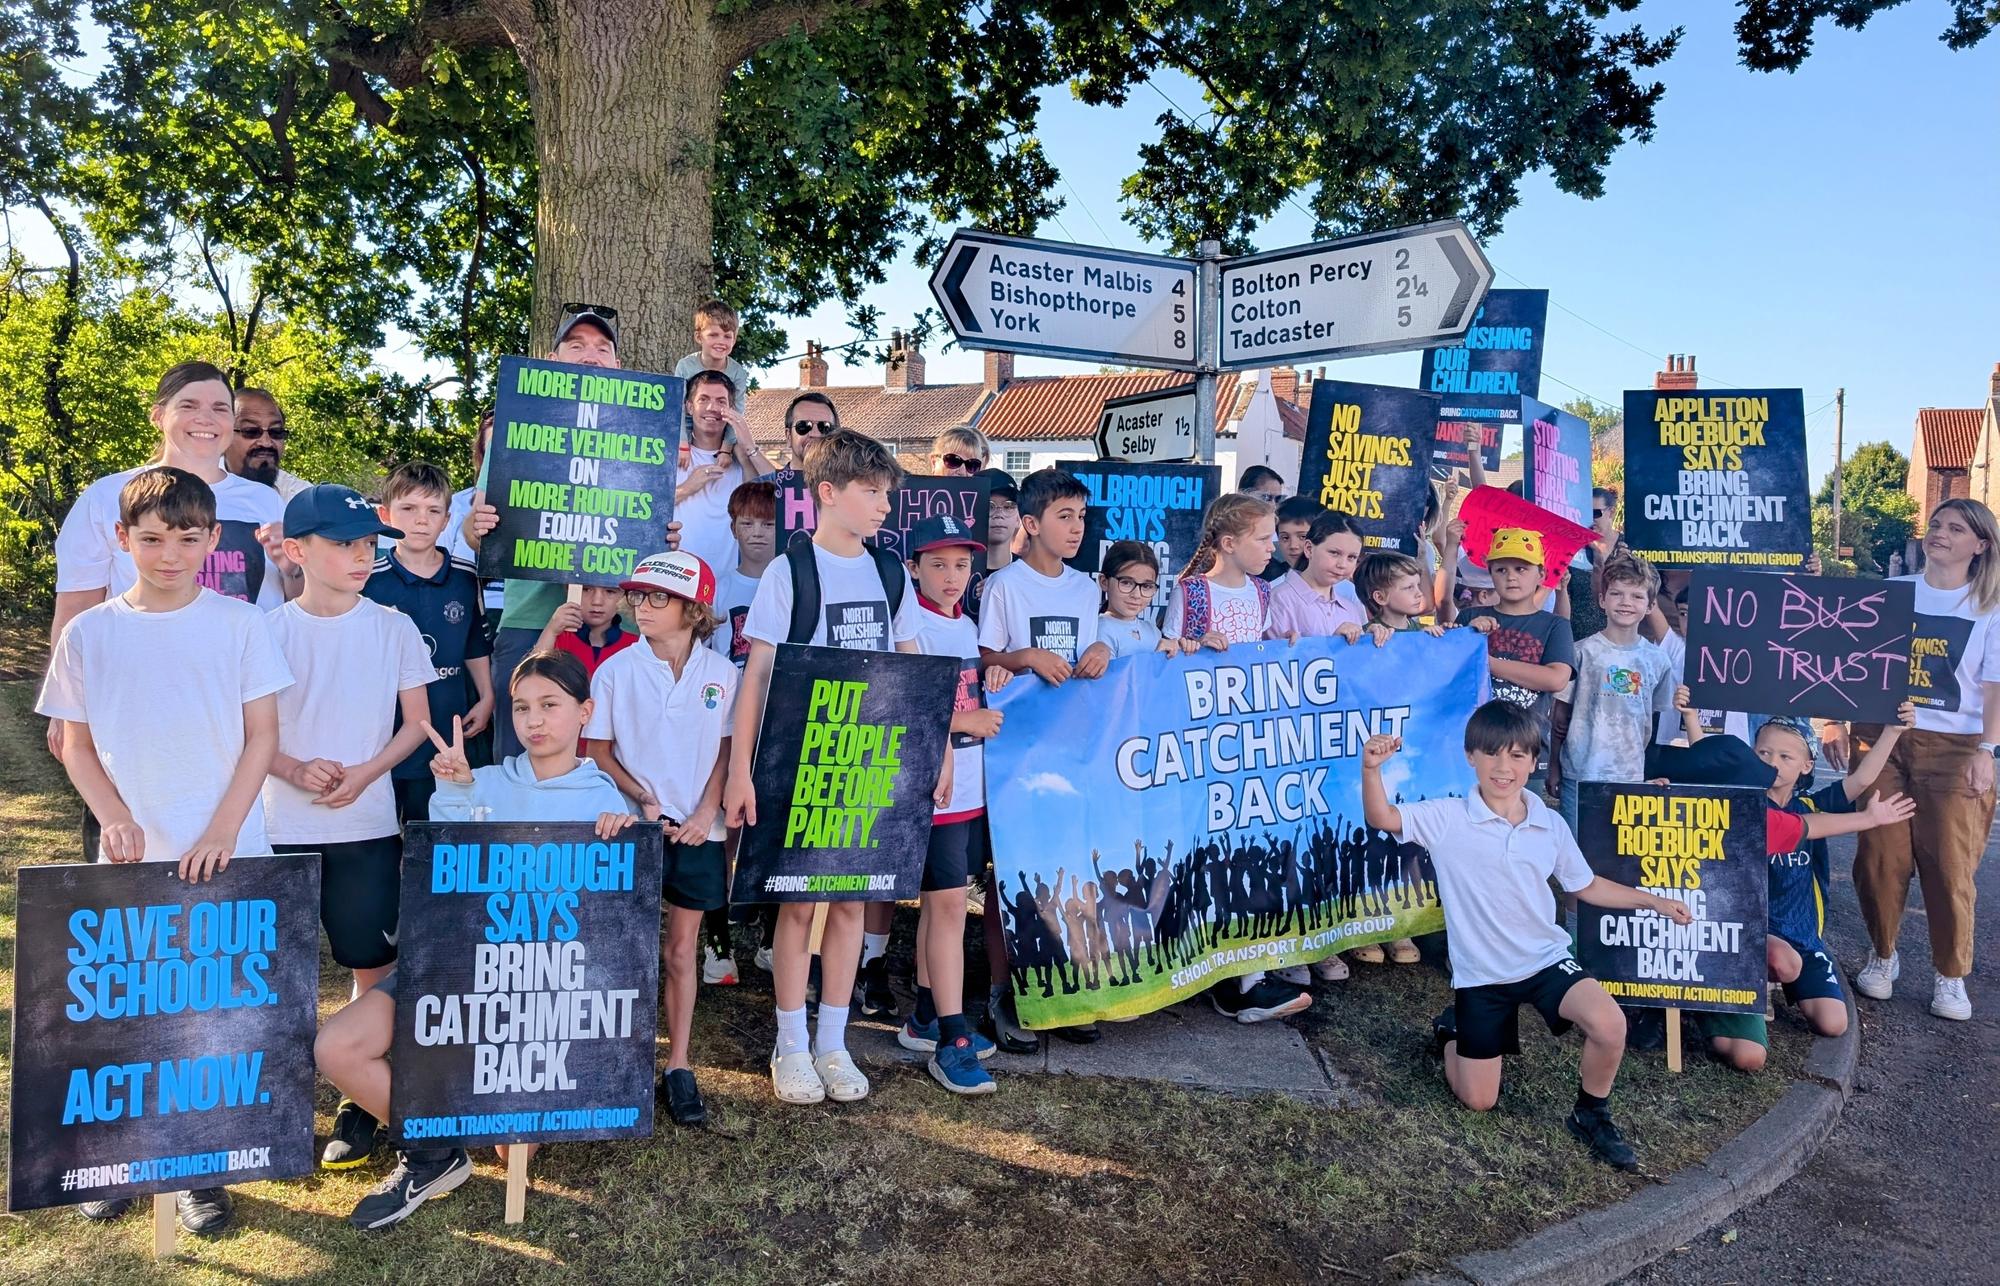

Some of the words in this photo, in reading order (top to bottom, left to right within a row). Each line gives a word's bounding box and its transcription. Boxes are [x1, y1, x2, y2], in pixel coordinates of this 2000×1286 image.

[989, 254, 1074, 284] Acaster
[1084, 266, 1153, 294] Malbis
[1171, 279, 1186, 298] 4
[1232, 272, 1300, 298] Bolton
[1310, 259, 1372, 285] Percy
[1395, 248, 1410, 271] 2
[990, 281, 1136, 319] Bishopthorpe
[1173, 304, 1186, 324] 5
[1231, 298, 1301, 324] Colton
[990, 307, 1041, 333] York
[1173, 329, 1187, 349] 8
[1230, 320, 1335, 349] Tadcaster
[1397, 305, 1412, 328] 5
[1434, 348, 1470, 371] OUR
[517, 367, 579, 400] MORE
[579, 375, 666, 411] DRIVERS
[1431, 371, 1520, 395] CHILDREN.
[576, 402, 599, 429] IN
[1116, 411, 1163, 433] Acaster
[1331, 403, 1362, 434] NO
[1654, 396, 1769, 422] APPLETON
[506, 421, 568, 455] MORE
[571, 428, 666, 465] VEHICLES
[1122, 435, 1156, 455] Selby
[1327, 431, 1413, 467] SAVINGS.
[1534, 418, 1560, 451] STOP
[1660, 421, 1766, 446] ROEBUCK
[568, 456, 600, 487] ON
[1323, 459, 1375, 491] JUST
[1534, 443, 1580, 484] HURTING
[1683, 445, 1743, 471] SAYS
[508, 480, 570, 514] MORE
[572, 486, 653, 520] ROUTES
[1535, 469, 1568, 504] RURAL
[1678, 470, 1749, 496] BRING
[1320, 486, 1384, 519] COSTS.
[1644, 494, 1787, 522] CATCHMENT
[538, 511, 618, 546] EQUALS
[1105, 507, 1166, 541] SAYS
[1681, 521, 1749, 548] BACK.
[513, 538, 577, 572] MORE
[582, 547, 637, 577] COST
[649, 567, 692, 582] FERRARI
[1730, 552, 1766, 566] ACTION
[1767, 553, 1804, 567] GROUP
[842, 606, 874, 624] NORTH
[1704, 586, 1758, 628] NO
[1780, 586, 1887, 634] BUS
[832, 622, 884, 641] YORKSHIRE
[1035, 635, 1077, 649] YORKSHIRE
[1045, 621, 1072, 635] NORTH
[1698, 646, 1752, 685] NO
[1768, 645, 1907, 692] TRUST
[807, 679, 869, 723] PUT
[1183, 657, 1338, 721] BRING
[799, 722, 907, 766] PEOPLE
[1115, 704, 1411, 792] CATCHMENT
[791, 764, 901, 807] BEFORE
[1206, 766, 1331, 834] BACK
[783, 806, 880, 849] PARTY.
[1612, 795, 1730, 830] APPLETON
[1617, 825, 1726, 860] ROEBUCK
[432, 842, 635, 894] BILBROUGH
[764, 874, 896, 893] #BRINGCATCHMENTBACK
[1640, 857, 1701, 889] SAYS
[67, 904, 181, 966] SAVE
[189, 899, 277, 956] OUR
[485, 892, 579, 943] SAYS
[1600, 914, 1743, 954] CATCHMENT
[1213, 937, 1297, 968] TRANSPORT
[1302, 927, 1343, 951] ACTION
[1344, 915, 1395, 937] GROUP
[474, 941, 585, 993] BRING
[1558, 960, 1583, 976] 10
[1637, 948, 1704, 981] BACK.
[66, 952, 278, 1022] SCHOOLS.
[1684, 986, 1722, 1002] ACTION
[1722, 989, 1757, 1005] GROUP
[414, 989, 639, 1046] CATCHMENT
[473, 1041, 577, 1095] BACK.
[62, 1062, 152, 1126] ACT
[158, 1051, 270, 1115] NOW.
[541, 1109, 594, 1132] ACTION
[593, 1107, 639, 1129] GROUP
[60, 1147, 271, 1191] #BRINGCATCHMENTBACK
